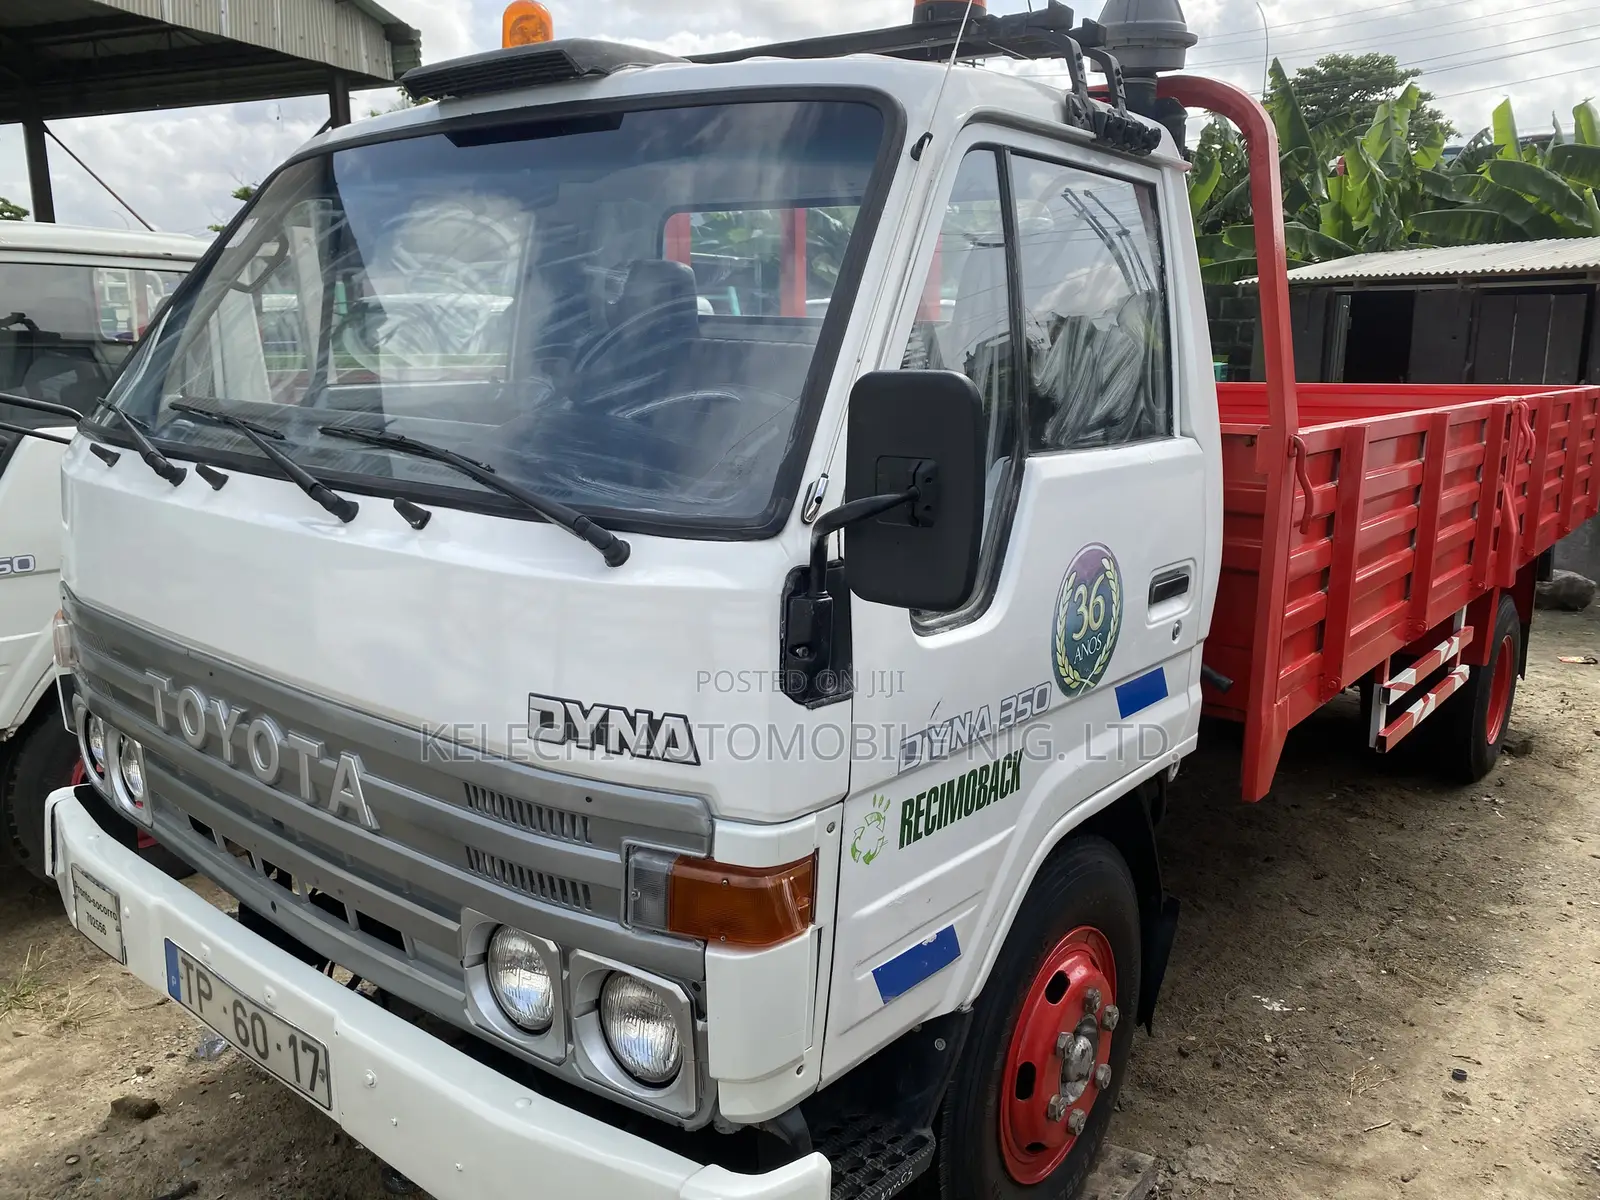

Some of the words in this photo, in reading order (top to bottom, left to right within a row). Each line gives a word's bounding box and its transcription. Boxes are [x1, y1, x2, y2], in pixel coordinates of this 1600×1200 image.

[1072, 573, 1106, 641] 36
[1073, 632, 1103, 665] ANOS
[145, 668, 381, 831] TOYOTA
[527, 692, 701, 767] DYNA
[897, 704, 993, 776] DYNA
[998, 680, 1053, 732] 350
[897, 747, 1025, 851] RECIMOBACK
